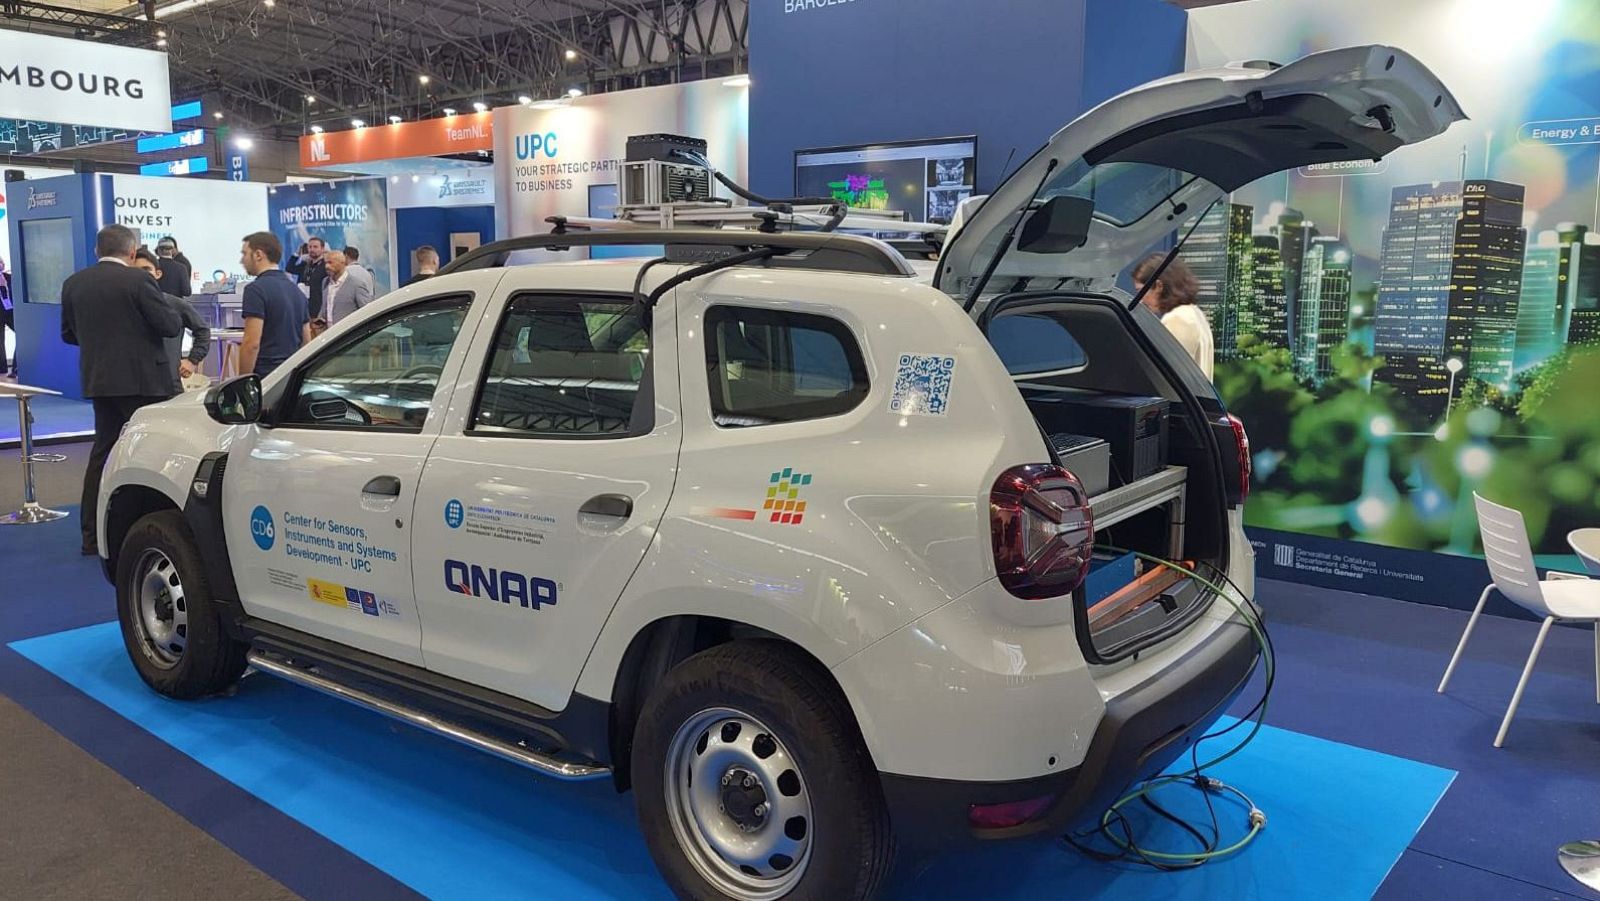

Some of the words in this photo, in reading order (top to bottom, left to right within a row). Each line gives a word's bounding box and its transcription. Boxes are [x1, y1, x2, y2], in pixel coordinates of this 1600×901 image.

[1532, 128, 1576, 139] Energy
[1580, 126, 1590, 136] &
[310, 139, 330, 162] NL
[516, 132, 557, 160] UPC
[515, 165, 538, 177] YOUR
[540, 162, 589, 176] STRATEGIC
[516, 181, 526, 192] TO
[528, 179, 572, 191] BUSINESS
[118, 215, 172, 227] INVEST
[280, 204, 368, 224] INFRASTRUCTORS
[252, 518, 274, 538] CD6
[284, 512, 311, 528] Center
[314, 517, 326, 529] for
[328, 520, 367, 541] Sensors,
[285, 528, 335, 549] Instruments
[337, 539, 354, 553] and
[356, 543, 397, 562] Systems
[286, 543, 342, 567] Development
[350, 557, 372, 573] UPC
[1334, 568, 1364, 579] General
[444, 559, 557, 611] QNAP
